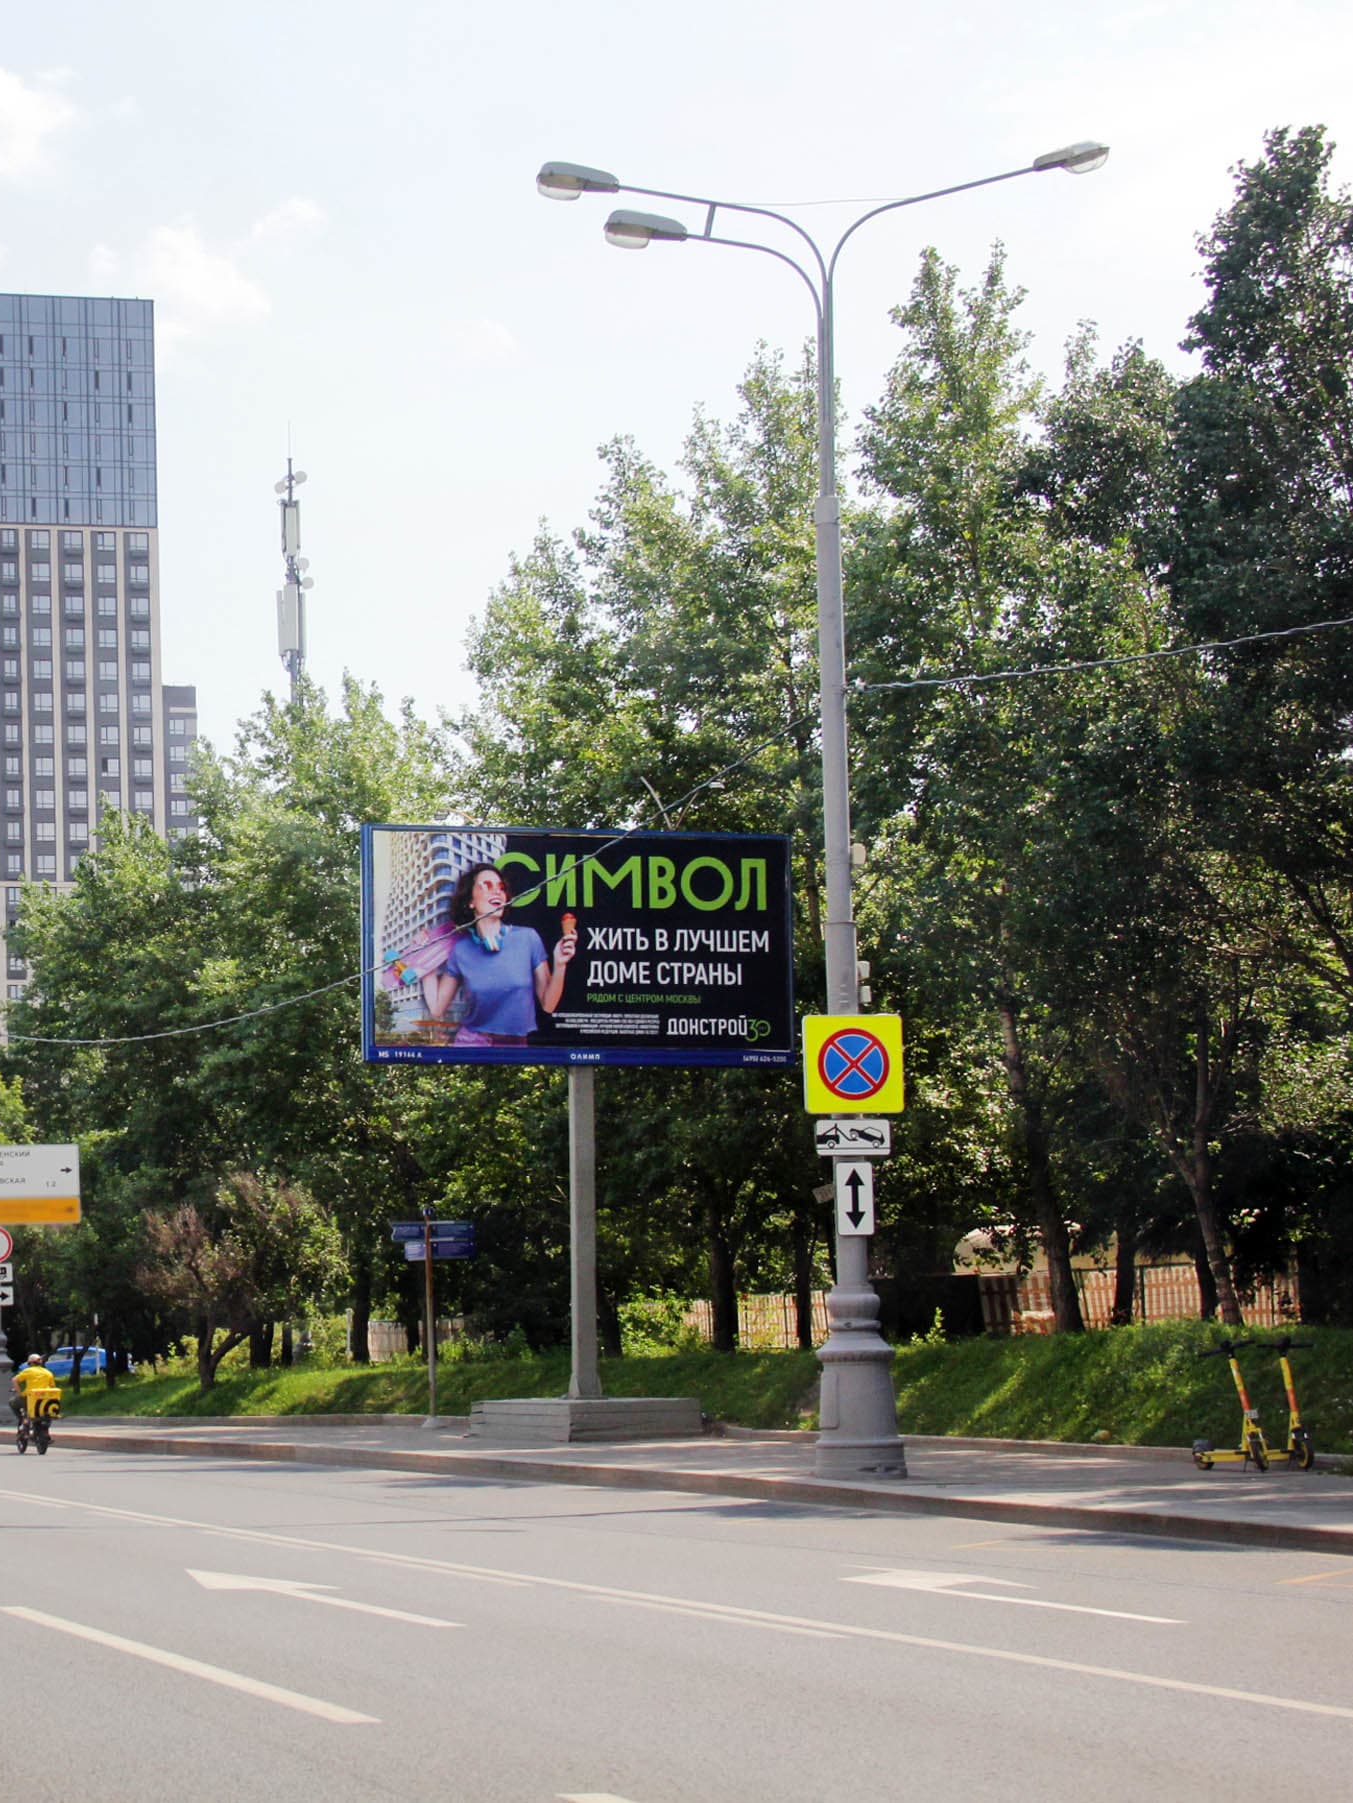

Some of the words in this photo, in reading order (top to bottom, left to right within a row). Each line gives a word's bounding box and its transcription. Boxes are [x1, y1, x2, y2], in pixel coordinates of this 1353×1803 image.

[495, 851, 768, 911] СИМВОЛ
[586, 927, 649, 951] ЖИТЬ
[655, 929, 669, 951] В
[674, 929, 770, 953] ЛУЧШЕМ
[587, 960, 651, 987] ДОМЕ
[656, 962, 743, 986] СТРАНЫ
[586, 992, 617, 1003] РЯДОМ
[625, 994, 664, 1004] ЦЕНТРОМ
[666, 1014, 748, 1036] ДОНСТРОЙ
